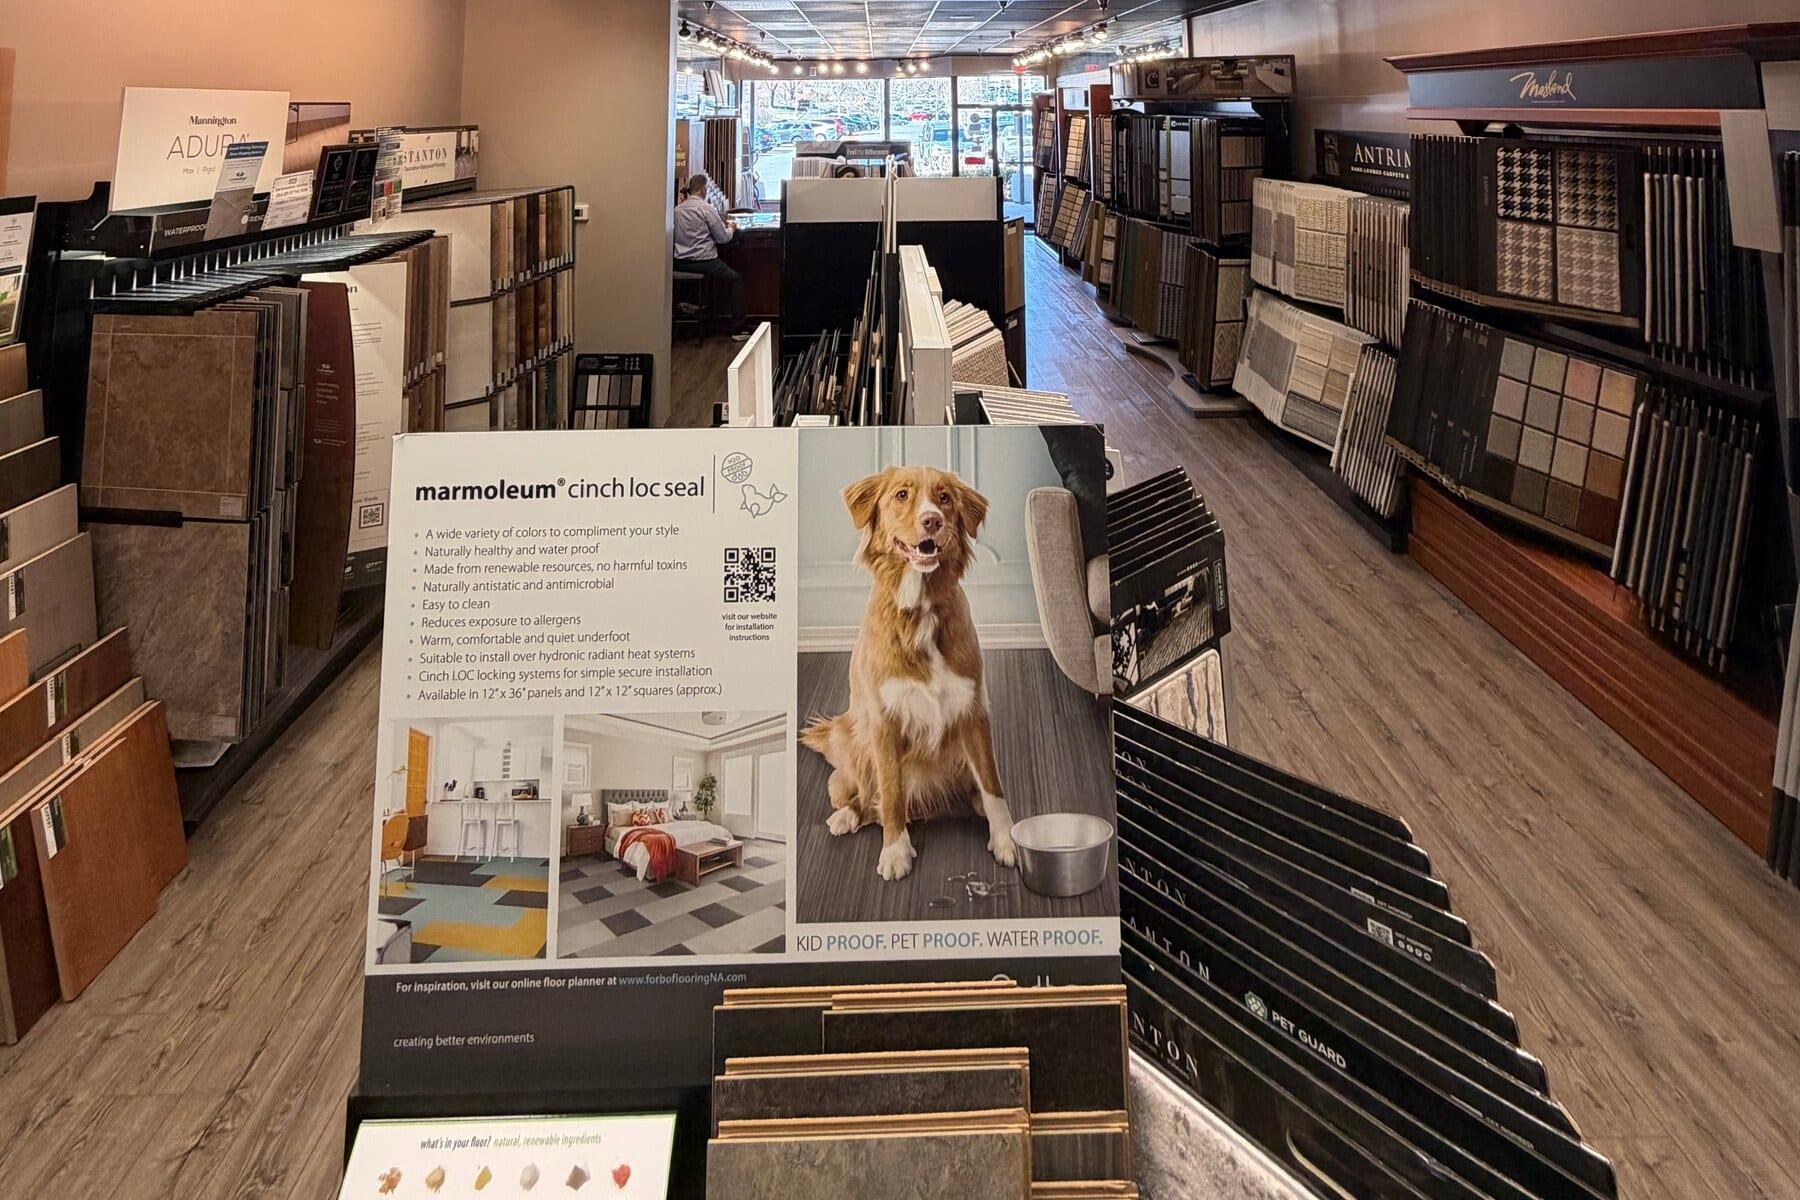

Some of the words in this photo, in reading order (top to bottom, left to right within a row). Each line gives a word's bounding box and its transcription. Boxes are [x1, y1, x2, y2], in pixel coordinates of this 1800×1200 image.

[189, 115, 237, 127] Mannington
[568, 477, 624, 498] cinch
[629, 476, 660, 498] loc
[664, 475, 705, 497] seal
[425, 528, 434, 540] A
[435, 527, 462, 539] wide
[464, 527, 500, 541] variety
[501, 525, 514, 538] of
[515, 525, 547, 538] colors
[548, 527, 561, 537] to
[562, 524, 627, 539] compliment
[628, 526, 653, 538] your
[655, 523, 679, 538] style
[424, 544, 472, 559] Naturally
[473, 544, 514, 558] healthy
[514, 543, 536, 556] and
[537, 544, 568, 555] water
[570, 541, 600, 556] proof
[423, 562, 454, 575] Made
[455, 561, 481, 574] from
[483, 560, 539, 574] renewable
[541, 562, 594, 573] resources,
[595, 562, 611, 571] no
[612, 558, 653, 571] harmful
[655, 558, 687, 571] toxins
[422, 579, 470, 594] Naturally
[471, 579, 520, 591] antistatic
[521, 578, 543, 590] and
[544, 576, 614, 590] antimicrobial
[422, 598, 446, 612] Easy
[447, 599, 460, 610] to
[461, 597, 490, 609] clean
[420, 615, 466, 628] Reduces
[467, 617, 517, 629] exposure
[519, 616, 531, 626] to
[532, 613, 581, 628] allergens
[721, 612, 736, 620] visit
[749, 611, 778, 620] website
[724, 622, 735, 631] for
[735, 622, 774, 631] installation
[419, 634, 454, 647] Warm,
[455, 631, 522, 645] comfortable
[523, 631, 545, 644] and
[546, 631, 575, 646] quiet
[577, 629, 630, 643] underfoot
[728, 633, 770, 641] instructions
[418, 651, 463, 664] Suitable
[465, 653, 477, 663] to
[479, 650, 510, 663] install
[512, 652, 537, 662] over
[538, 648, 585, 664] hydronic
[587, 648, 625, 660] radiant
[627, 647, 651, 660] heat
[653, 648, 695, 662] systems
[418, 669, 449, 682] Cinch
[451, 668, 475, 681] LOC
[476, 668, 516, 683] locking
[518, 669, 560, 682] systems
[562, 666, 578, 679] for
[579, 665, 616, 681] simple
[617, 667, 653, 678] secure
[654, 664, 712, 677] installation
[417, 688, 466, 700] Available
[469, 688, 479, 699] in
[509, 687, 526, 699] 36"
[527, 686, 562, 700] panels
[564, 685, 585, 697] and
[633, 686, 674, 698] squares
[676, 683, 722, 697] (approx.)
[796, 934, 822, 952] KID
[826, 933, 887, 951] PROOF.
[890, 932, 919, 949] PET
[922, 931, 983, 948] PROOF.
[985, 929, 1039, 947] WATER
[1042, 929, 1103, 945] PROOF.
[395, 981, 412, 992] For
[413, 979, 469, 994] inspiration,
[470, 978, 490, 990] visit
[491, 980, 510, 989] our
[510, 977, 542, 989] online
[542, 976, 566, 987] floor
[567, 975, 605, 989] planner
[606, 975, 617, 986] at
[618, 971, 747, 985] www.forboflooringNA.com
[392, 1035, 433, 1049] creating
[434, 1034, 466, 1046] better
[466, 1032, 534, 1045] environments
[1272, 1009, 1295, 1034] PET
[1298, 1029, 1347, 1068] GUARD
[420, 1136, 443, 1149] what's
[444, 1136, 452, 1148] in
[453, 1138, 469, 1150] your
[470, 1136, 491, 1149] floor?
[493, 1135, 521, 1148] natural,
[523, 1134, 560, 1147] renewable
[562, 1133, 602, 1148] ingredients
